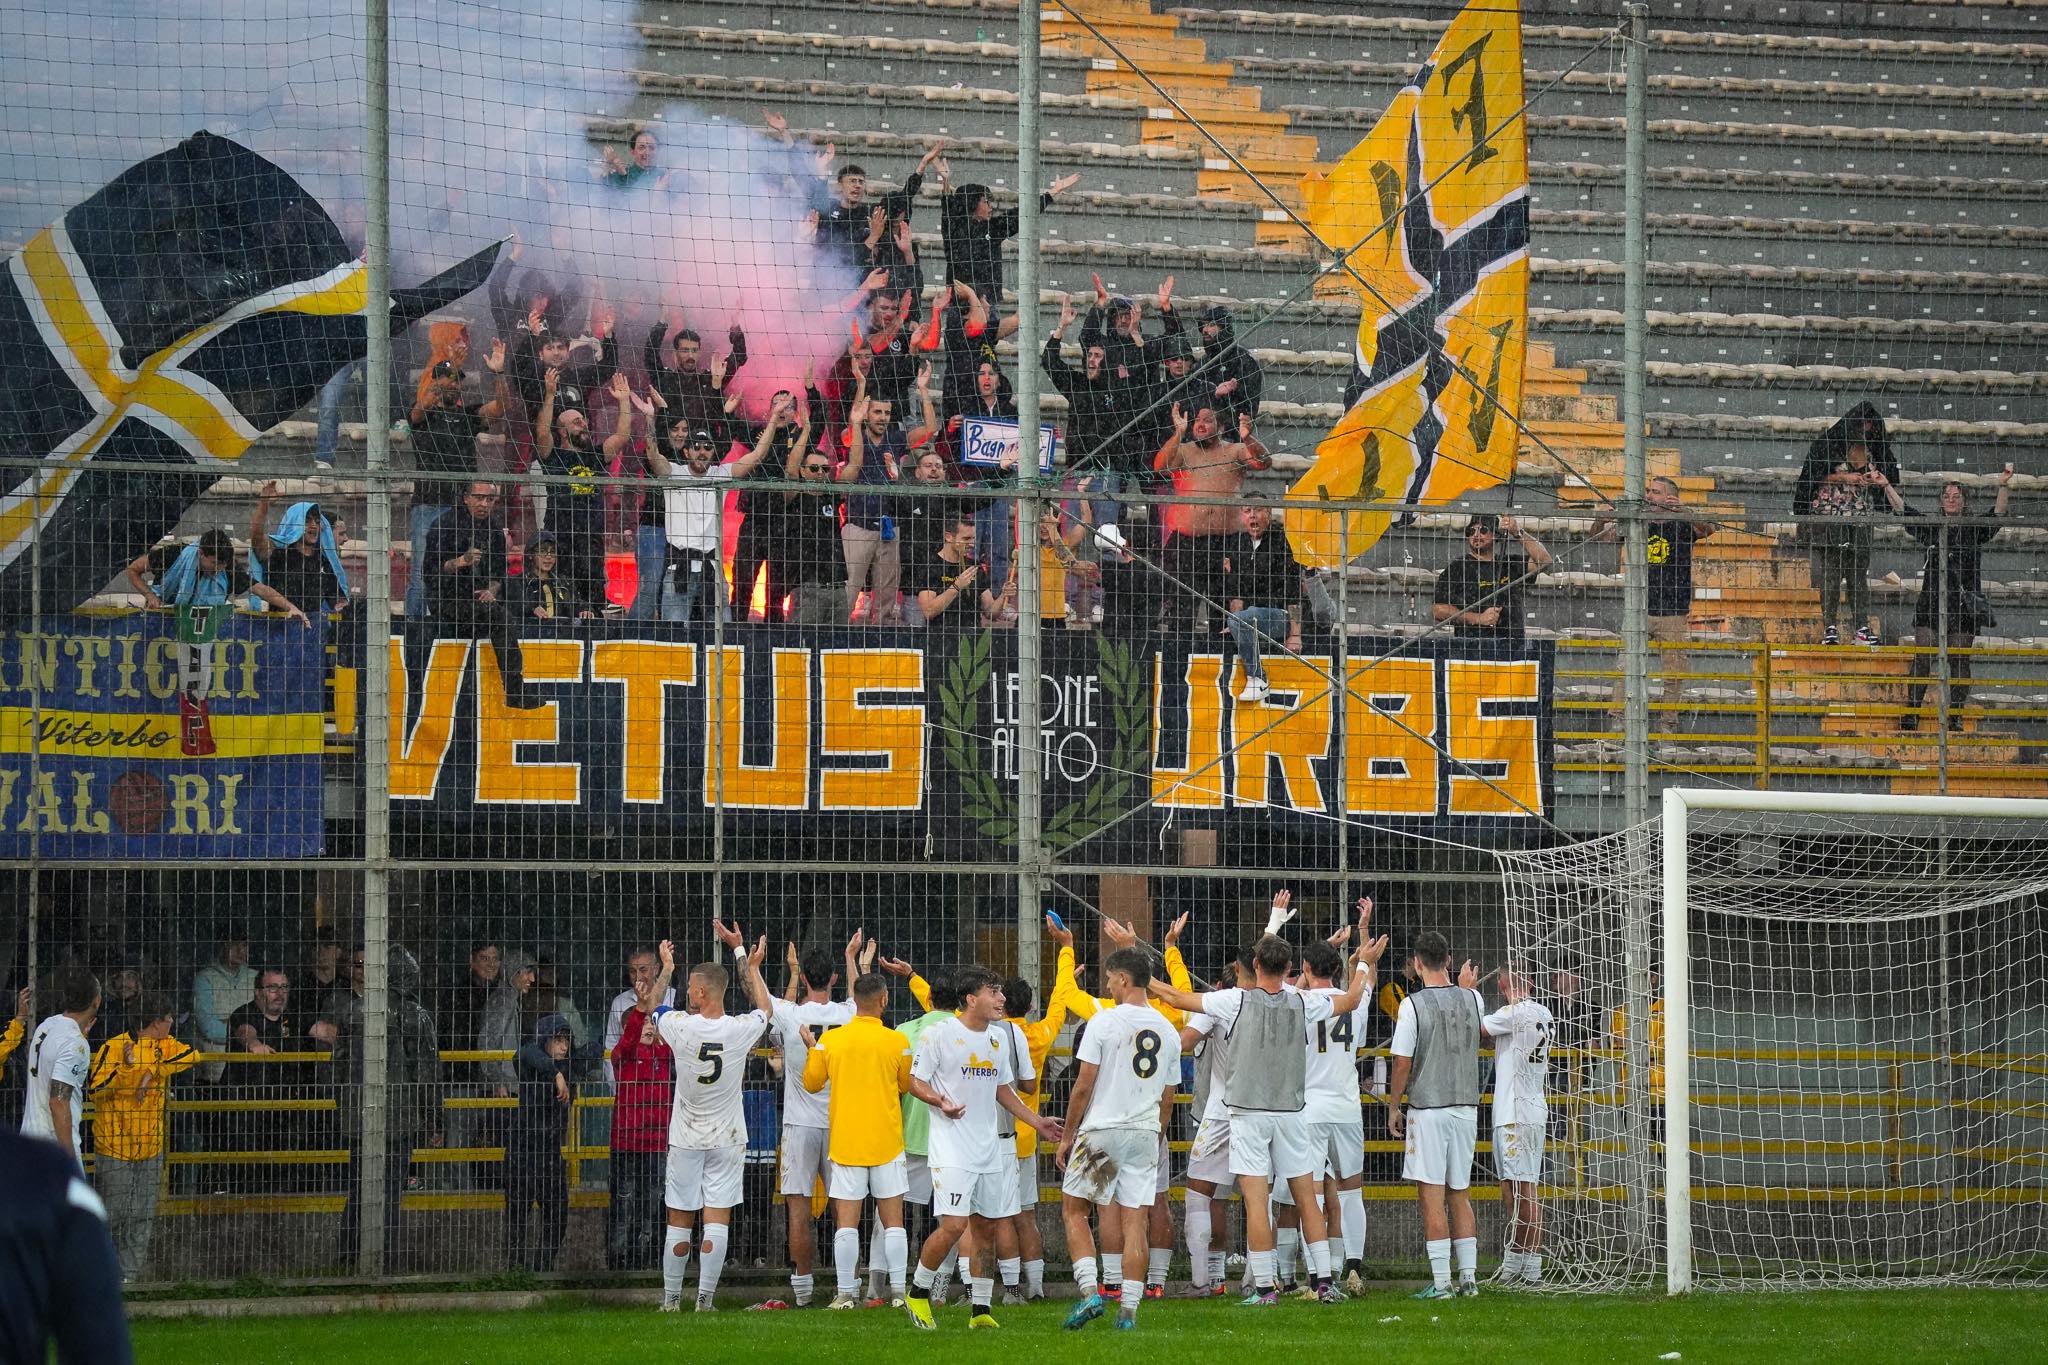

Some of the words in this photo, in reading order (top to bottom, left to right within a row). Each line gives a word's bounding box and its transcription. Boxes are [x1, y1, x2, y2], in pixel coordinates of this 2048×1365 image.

[23, 717, 177, 748] Viterbo
[389, 635, 924, 811] VETUS
[1152, 652, 1545, 817] URBS
[1132, 1029, 1162, 1079] 8
[1317, 1012, 1354, 1054] 14
[697, 1042, 724, 1084] 5
[961, 1066, 998, 1078] VITERBO
[950, 1193, 962, 1207] 17
